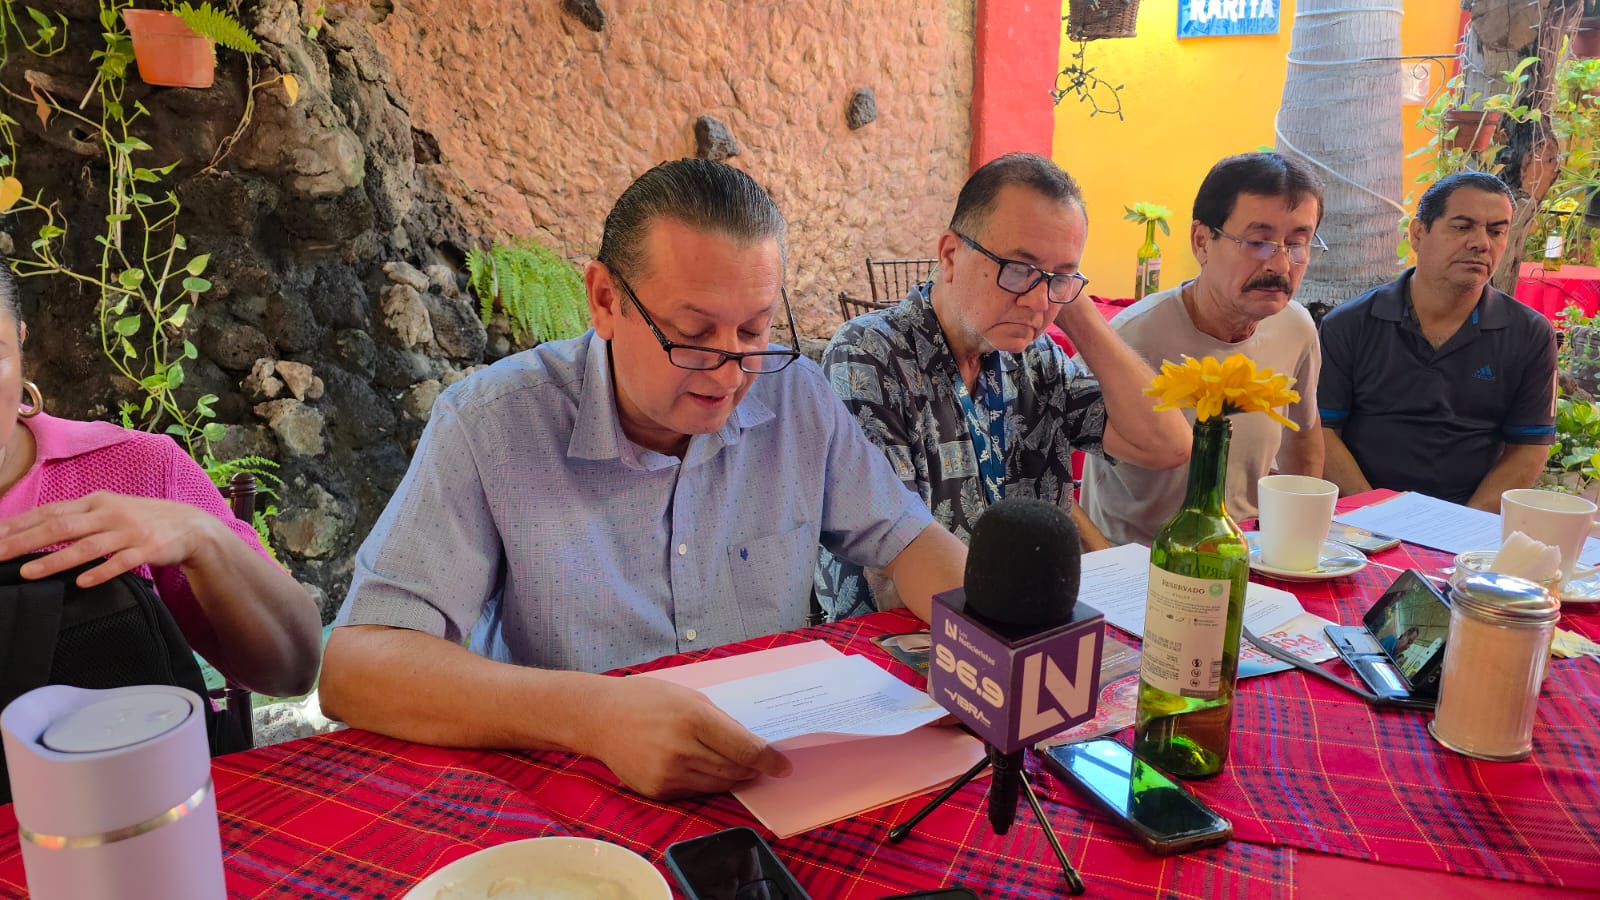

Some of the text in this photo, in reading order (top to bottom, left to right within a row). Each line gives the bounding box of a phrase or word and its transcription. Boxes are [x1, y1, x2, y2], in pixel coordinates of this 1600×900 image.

[935, 643, 1004, 708] 96.9
[944, 688, 991, 727] VIBRA
[1018, 632, 1096, 741] LN
